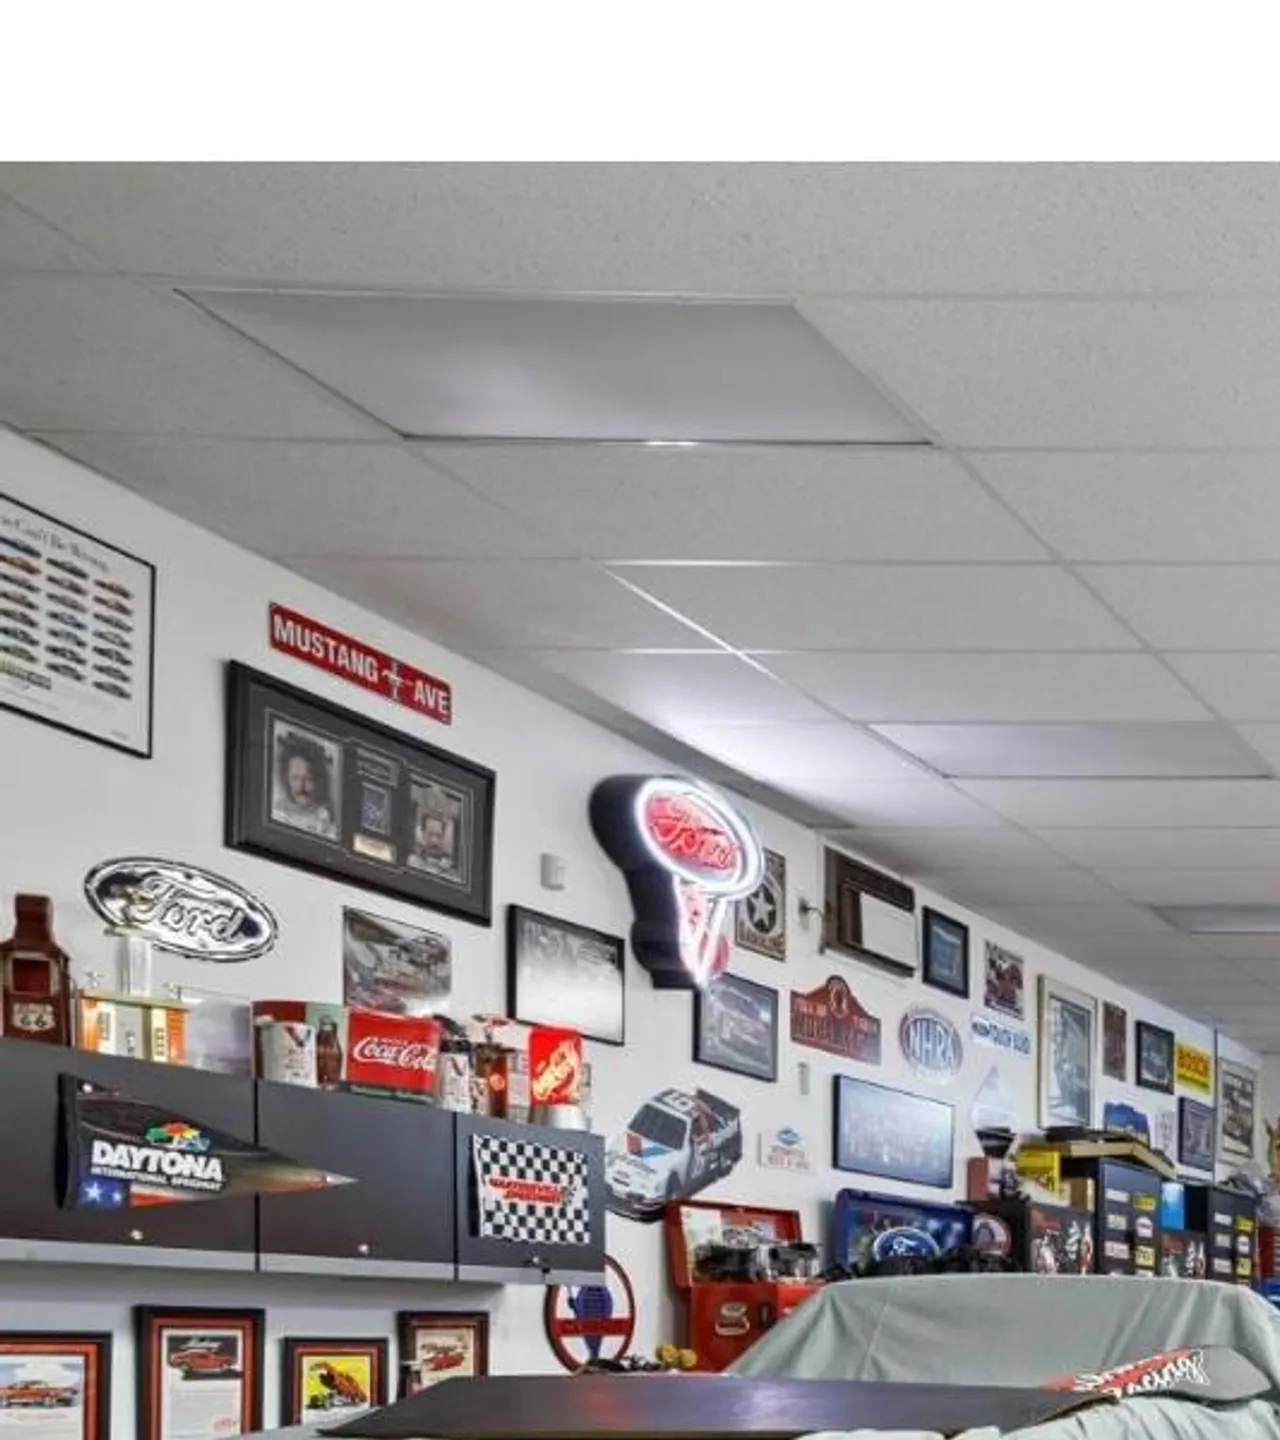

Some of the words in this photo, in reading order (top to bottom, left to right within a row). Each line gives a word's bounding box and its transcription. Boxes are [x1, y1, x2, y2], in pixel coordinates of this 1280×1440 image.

[273, 614, 379, 684] MUSTANG
[413, 680, 449, 715] AVE
[120, 870, 246, 945] Ford
[353, 1037, 437, 1072] Coca-Cola
[908, 1018, 956, 1069] NHRA
[91, 1139, 223, 1182] DAYTONA
